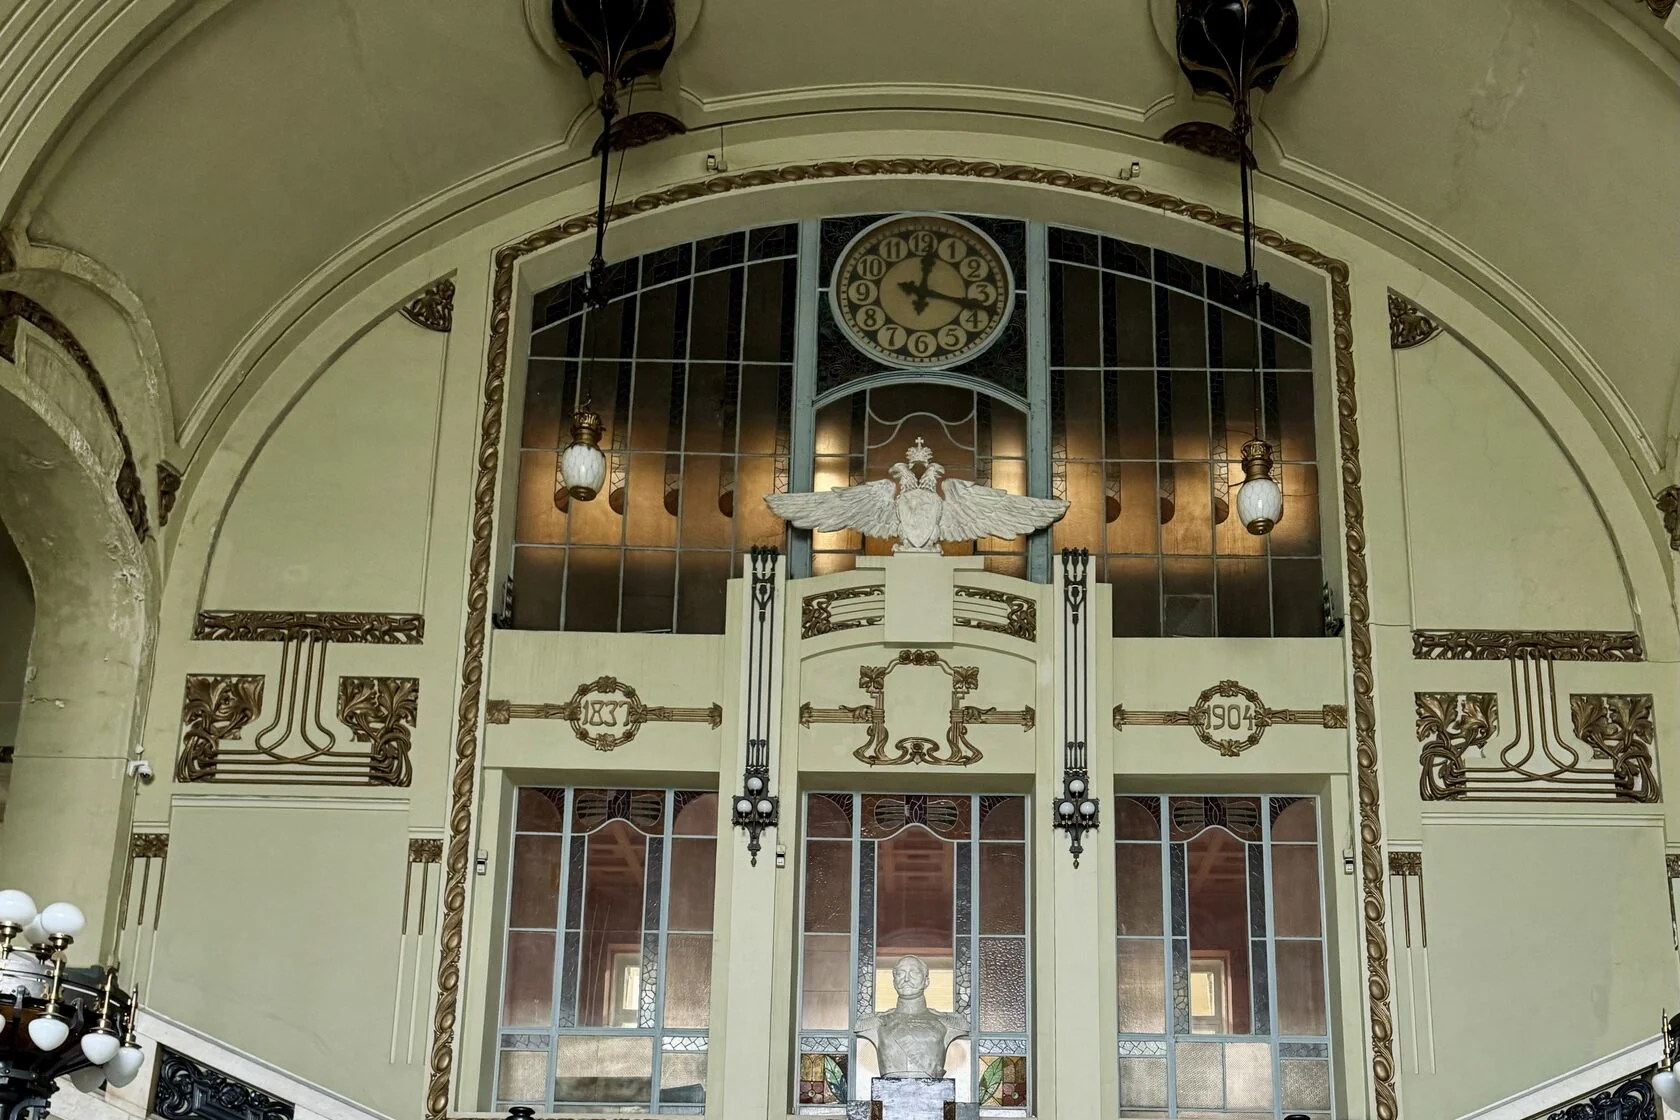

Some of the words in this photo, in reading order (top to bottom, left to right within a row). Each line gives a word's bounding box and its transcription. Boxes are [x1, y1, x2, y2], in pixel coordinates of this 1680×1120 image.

[885, 239, 903, 259] 11
[913, 232, 933, 253] 12
[948, 239, 957, 260] 1
[860, 257, 882, 279] 10
[967, 259, 981, 279] 2
[855, 282, 870, 302] 9
[975, 284, 990, 304] 3
[864, 308, 878, 327] 8
[965, 310, 983, 329] 4
[885, 326, 898, 347] 7
[914, 333, 929, 354] 6
[946, 328, 960, 348] 5
[582, 700, 631, 727] 1837
[1204, 704, 1255, 731] 1904
